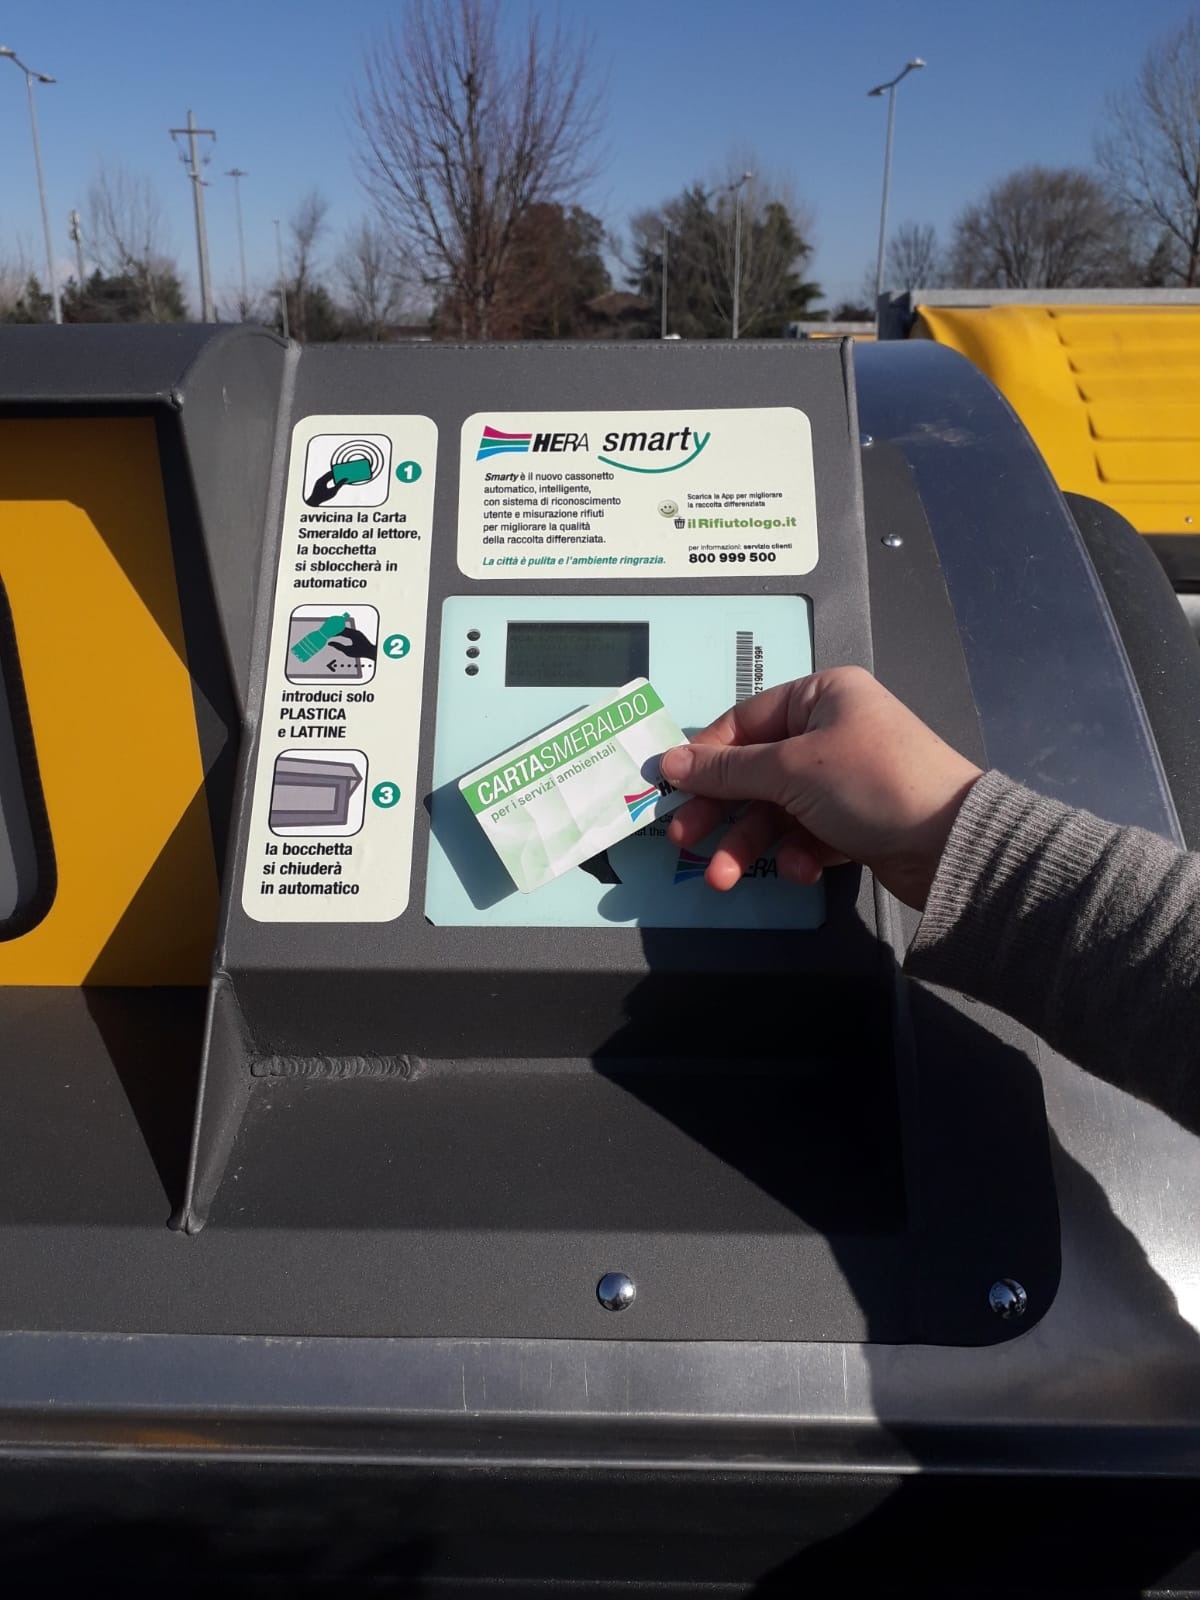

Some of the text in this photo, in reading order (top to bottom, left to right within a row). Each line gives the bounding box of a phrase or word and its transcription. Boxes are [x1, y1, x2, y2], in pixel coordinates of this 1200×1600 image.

[532, 433, 589, 452] HERA
[602, 426, 711, 462] smarty
[404, 465, 413, 479] 1
[484, 472, 519, 482] Smarty
[520, 472, 526, 481] è
[528, 472, 533, 481] il
[565, 473, 614, 481] cassonetto
[484, 485, 592, 495] automatico, intelligente,
[484, 497, 622, 506] con sistema di riconoscimento
[721, 493, 734, 501] App
[749, 492, 783, 500] migliorare
[300, 511, 407, 523] avvicina la Carta
[523, 510, 578, 518] misurazione
[580, 509, 605, 518] rifiuti
[483, 522, 591, 533] per migliorare la qualità
[298, 528, 421, 541] Smeraldo al lettore,
[482, 535, 606, 544] della raccolta differenziata.
[297, 544, 376, 555] la bocchetta
[482, 557, 495, 566] La
[496, 557, 519, 566] città
[521, 556, 527, 565] è
[528, 556, 556, 567] pulita
[566, 556, 618, 565] l'ambiente
[619, 555, 666, 567] ringrazia.
[688, 552, 777, 563] 800 999 500
[295, 560, 398, 572] si sbloccherà in
[293, 577, 367, 589] automatico
[389, 639, 404, 655] 2
[282, 690, 375, 703] introduci solo
[280, 708, 346, 720] PLASTICA
[278, 726, 347, 738] e LATTINE
[477, 693, 649, 805] CARTASMERALDO
[490, 807, 511, 824] per
[519, 777, 556, 807] servizi
[557, 742, 617, 785] ambientali
[379, 787, 393, 804] 3
[265, 843, 353, 855] la bocchetta
[262, 861, 342, 875] si chiuderà
[260, 881, 360, 894] in automatico
